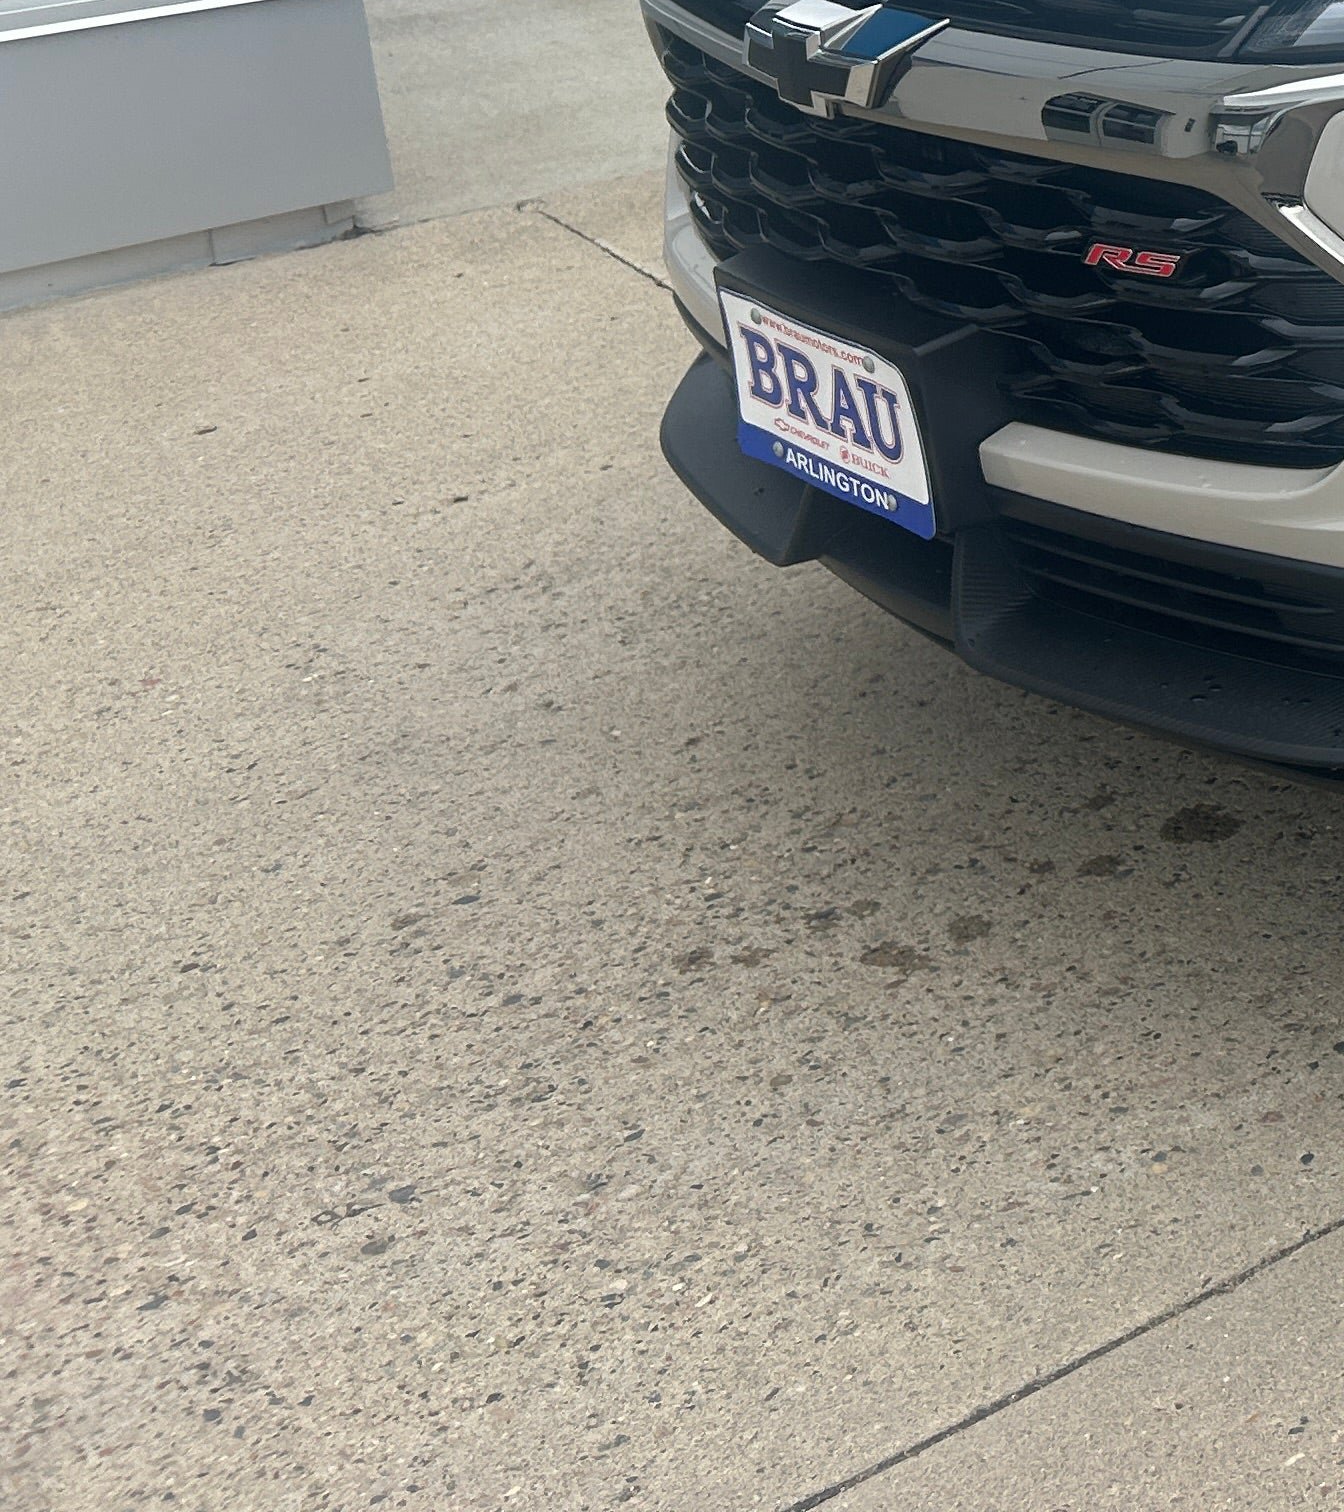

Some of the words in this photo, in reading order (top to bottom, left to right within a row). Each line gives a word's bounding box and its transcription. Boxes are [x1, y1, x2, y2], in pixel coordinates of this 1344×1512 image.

[1084, 243, 1181, 278] RS
[738, 322, 904, 465] BRAU
[786, 448, 889, 510] ARLINGTON
[851, 453, 889, 479] BUICK
